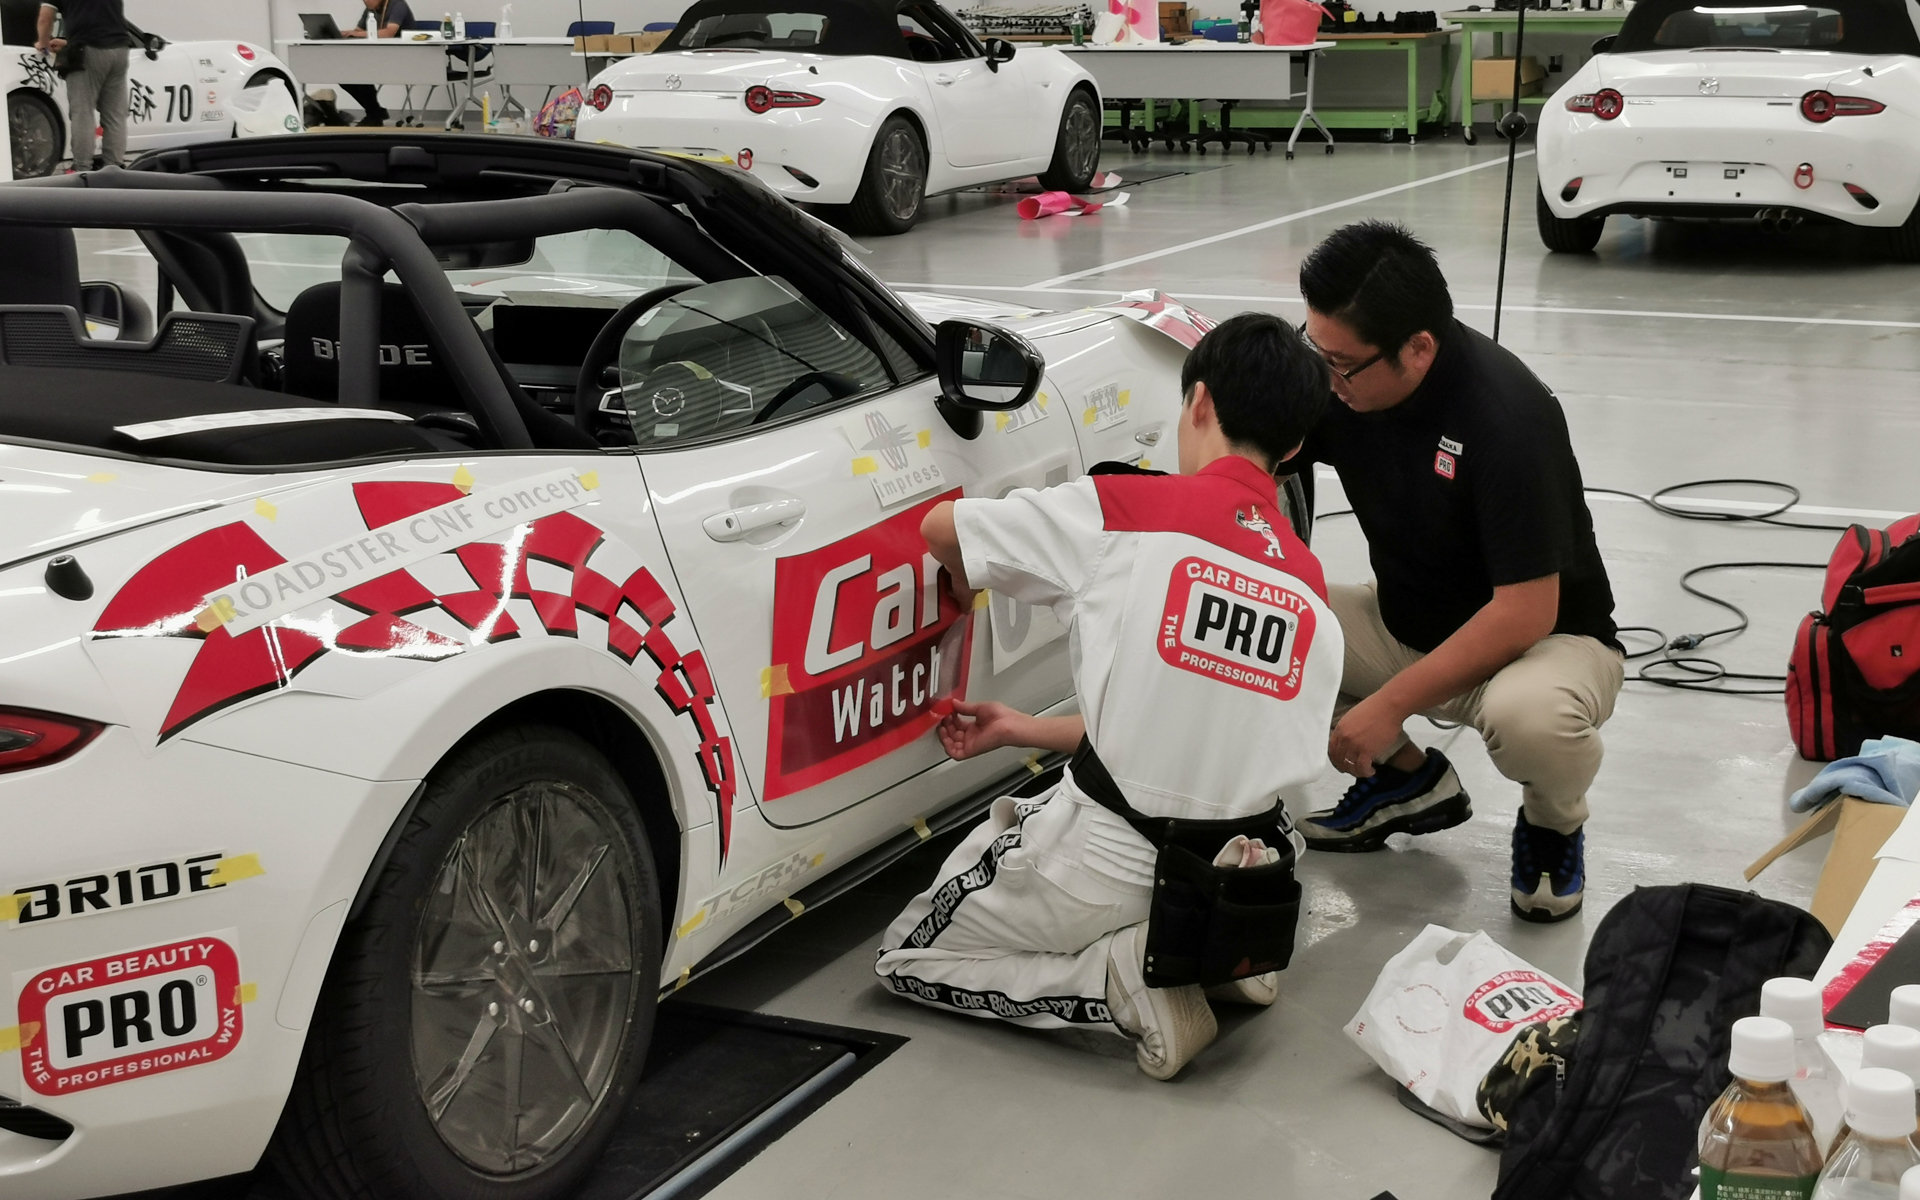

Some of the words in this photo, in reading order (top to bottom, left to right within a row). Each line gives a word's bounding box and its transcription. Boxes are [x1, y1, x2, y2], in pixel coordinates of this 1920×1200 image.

[164, 84, 193, 123] 70
[312, 337, 432, 365] BDE
[872, 464, 940, 498] impress
[211, 531, 410, 624] ROADSTER
[409, 503, 475, 544] CNF
[1186, 562, 1231, 587] CAR
[1234, 576, 1308, 615] BEAUTY
[804, 552, 945, 676] Car
[1164, 615, 1178, 648] THE
[1180, 651, 1280, 692] PROFESSIONAL
[1285, 656, 1301, 689] WAY
[831, 645, 940, 743] Watch
[13, 853, 226, 923] BRIDE
[702, 862, 786, 916] TCR
[37, 966, 94, 994] CAR
[106, 944, 214, 978] BEAUTY
[1465, 984, 1491, 1008] CAR
[1492, 971, 1540, 986] BEAUTY
[951, 990, 988, 1009] CAR
[30, 1047, 51, 1084] THE
[57, 1046, 212, 1089] PROFESSIONAL
[217, 1007, 235, 1044] WAY
